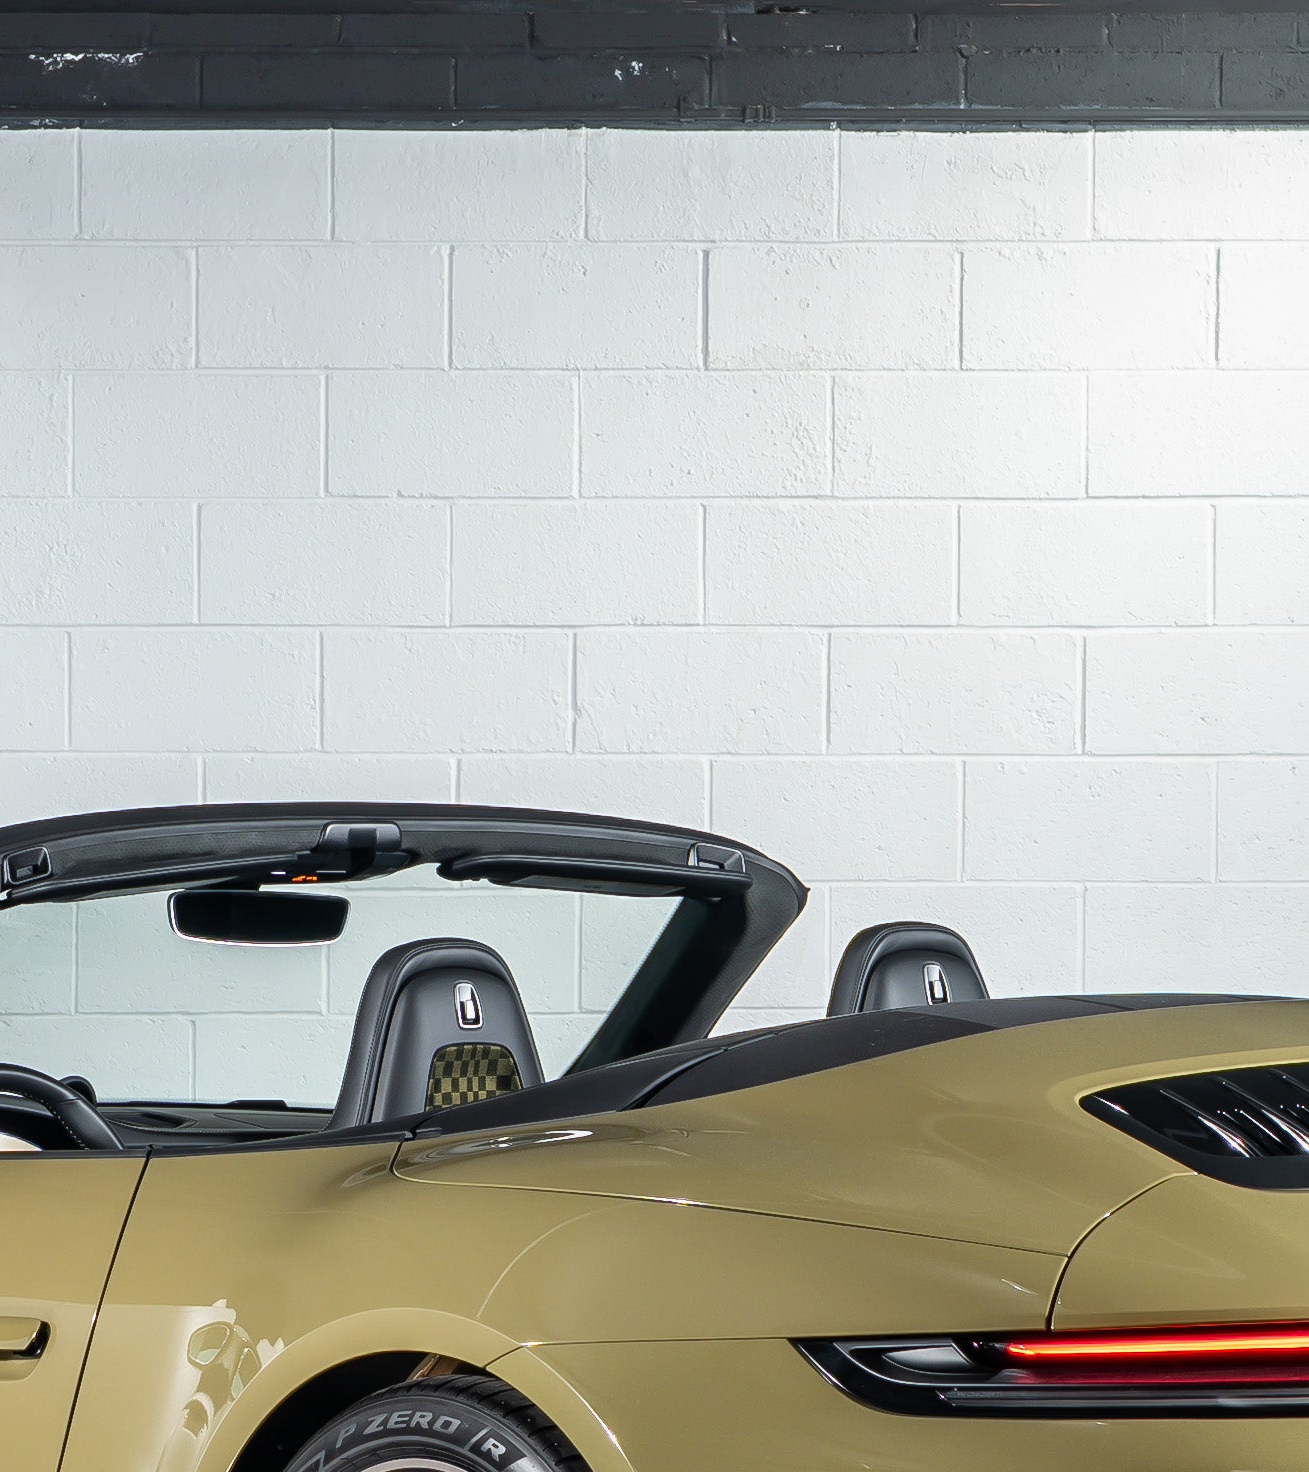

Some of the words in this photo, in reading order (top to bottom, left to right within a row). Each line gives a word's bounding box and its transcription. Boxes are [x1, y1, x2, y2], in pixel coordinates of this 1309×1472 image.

[336, 1422, 357, 1449] P
[363, 1410, 462, 1435] ZERO
[480, 1438, 507, 1462] R
